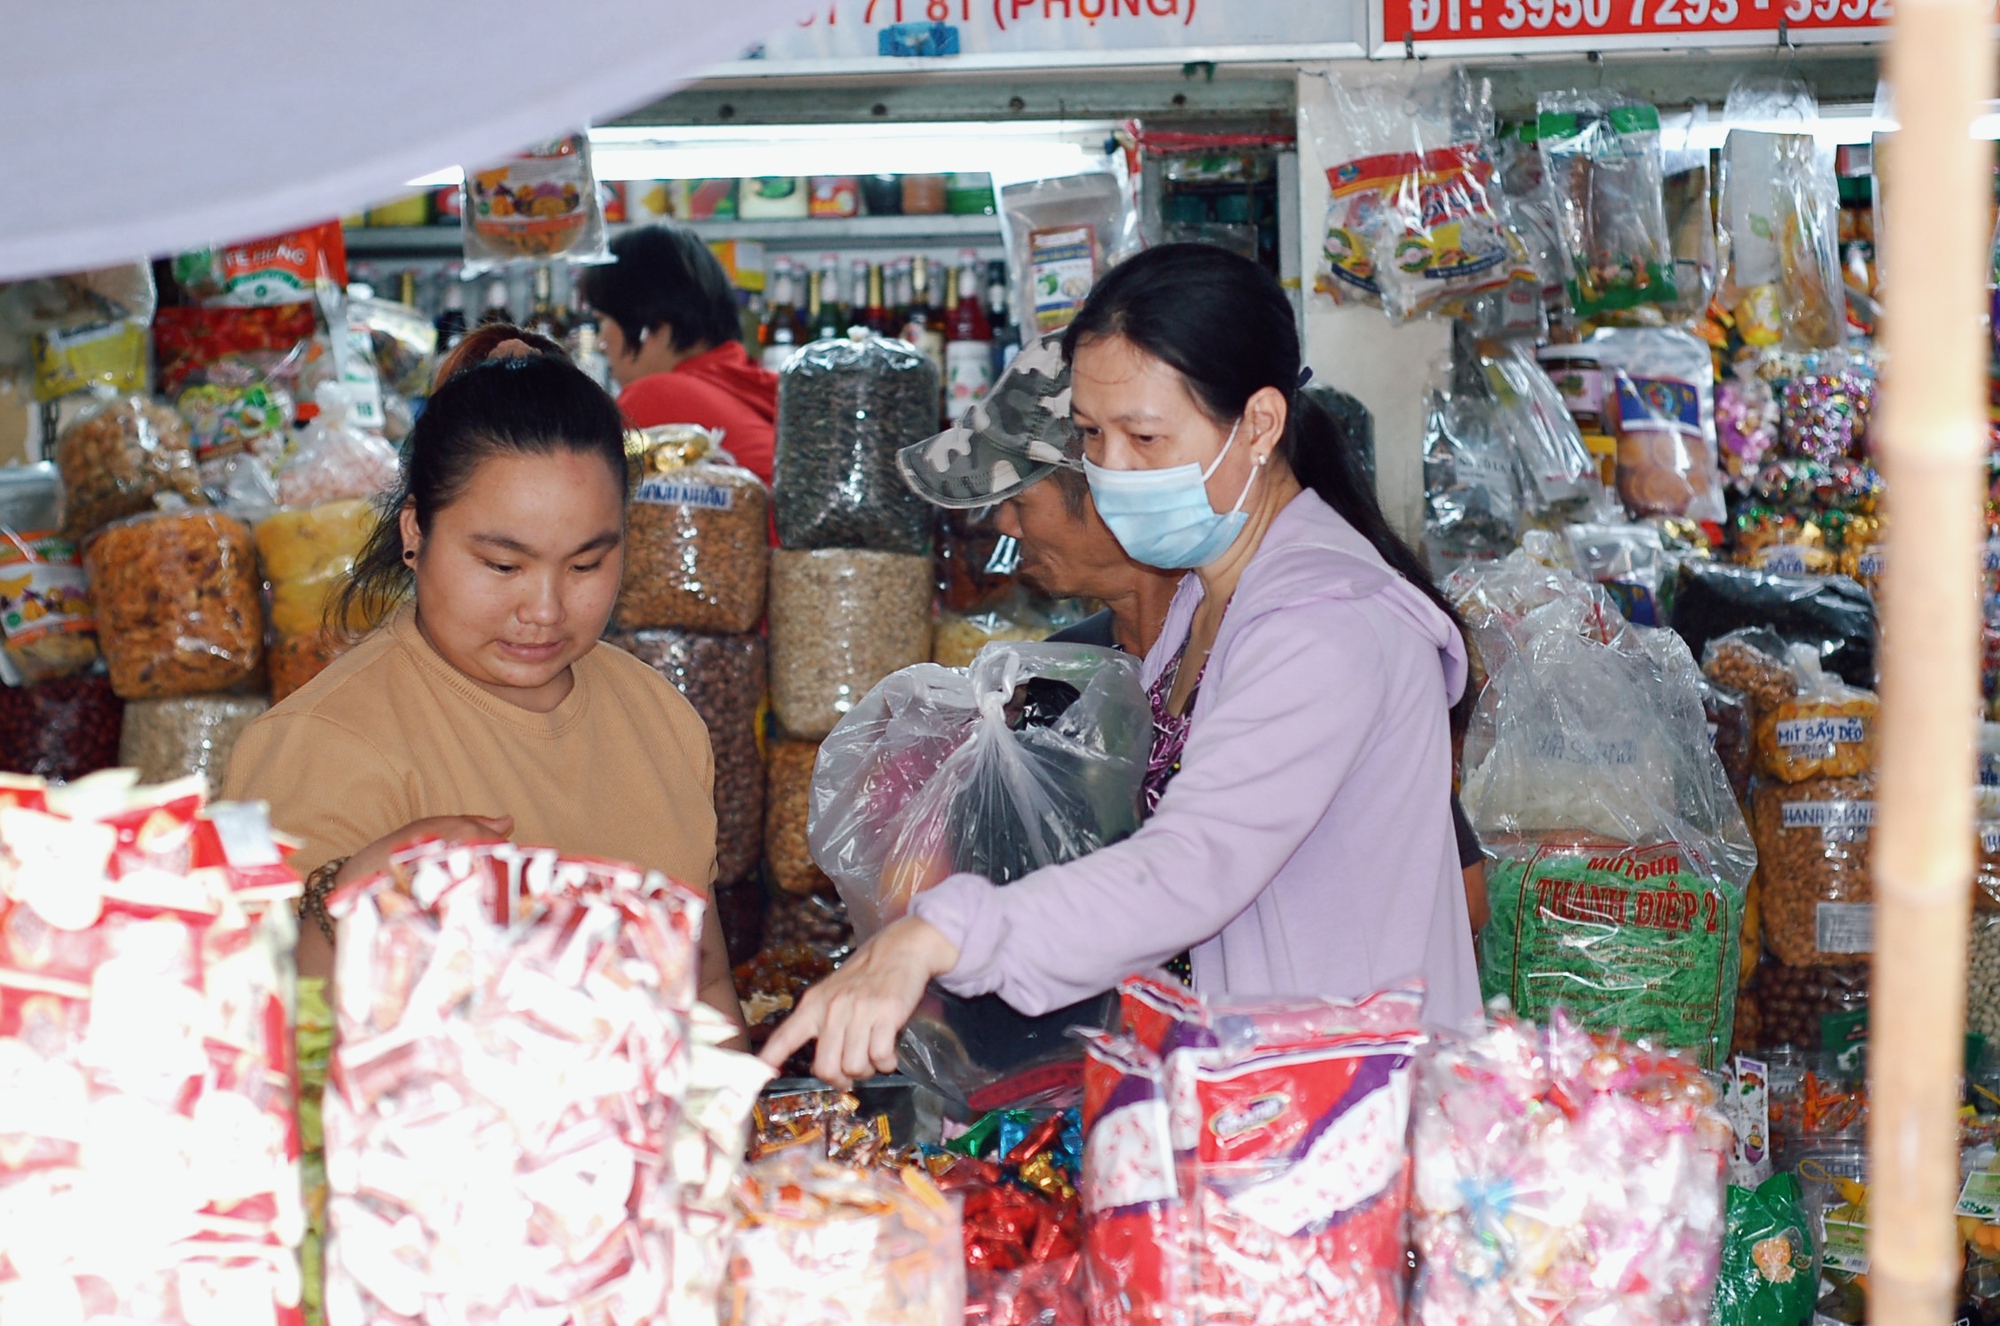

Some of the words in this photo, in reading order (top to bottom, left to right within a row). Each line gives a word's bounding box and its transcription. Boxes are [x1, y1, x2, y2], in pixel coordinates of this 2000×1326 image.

[1534, 877, 1629, 928] THANH
[1634, 878, 1700, 941] ĐIỆP
[1703, 890, 1719, 935] 2
